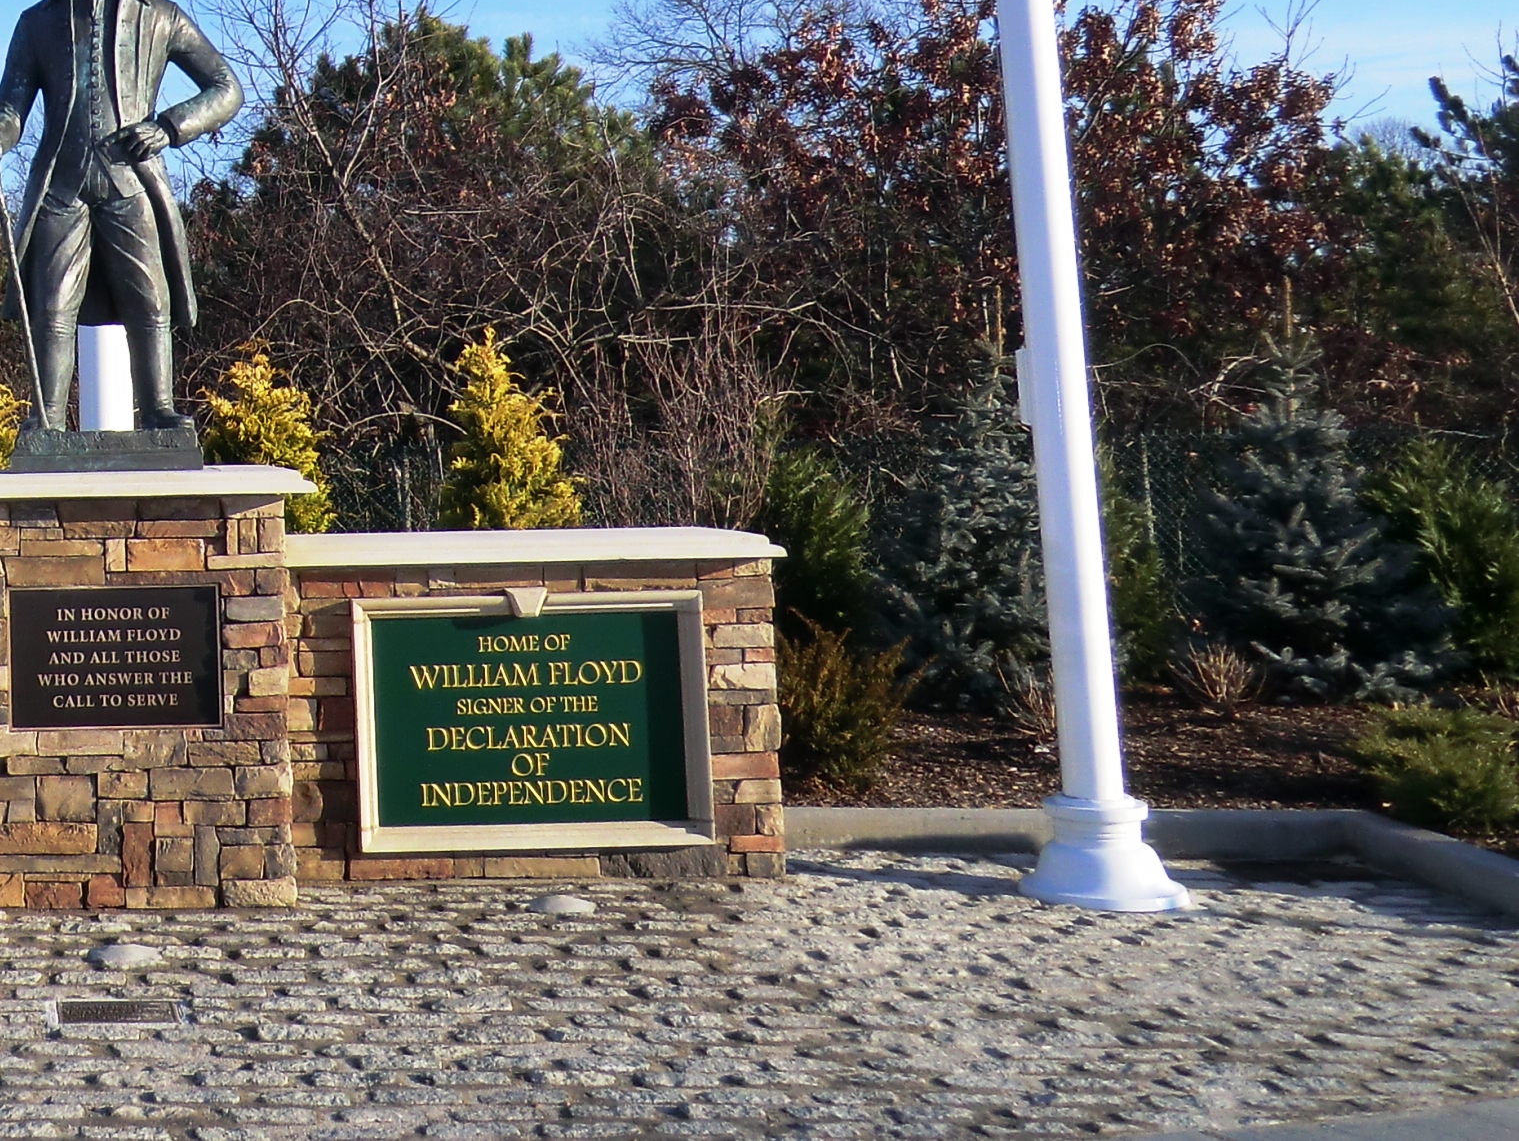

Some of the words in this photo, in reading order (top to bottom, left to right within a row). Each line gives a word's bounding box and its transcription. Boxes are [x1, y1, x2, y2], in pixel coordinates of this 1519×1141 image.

[57, 608, 75, 621] IN
[81, 607, 142, 620] HONOR
[148, 607, 170, 619] OF
[46, 630, 122, 643] WILLIAM
[127, 629, 181, 641] FLOYD
[478, 635, 540, 653] HOME
[544, 634, 570, 651] OF
[49, 652, 84, 664] AND
[90, 651, 120, 663] ALL
[125, 650, 181, 663] THOSE
[38, 674, 79, 686] WHO
[84, 672, 154, 685] ANSWER
[159, 671, 192, 684] THE
[410, 663, 541, 690] WILLIAM
[549, 660, 642, 685] FLOYD
[53, 695, 94, 707] CALL
[100, 695, 122, 707] TO
[128, 694, 178, 706] SERVE
[457, 698, 524, 716] SIGNER
[530, 697, 558, 713] OF
[560, 696, 598, 712] THE
[427, 723, 631, 751] DECLARATION
[511, 753, 549, 777] OF
[421, 779, 643, 807] INDEPENDENCE
